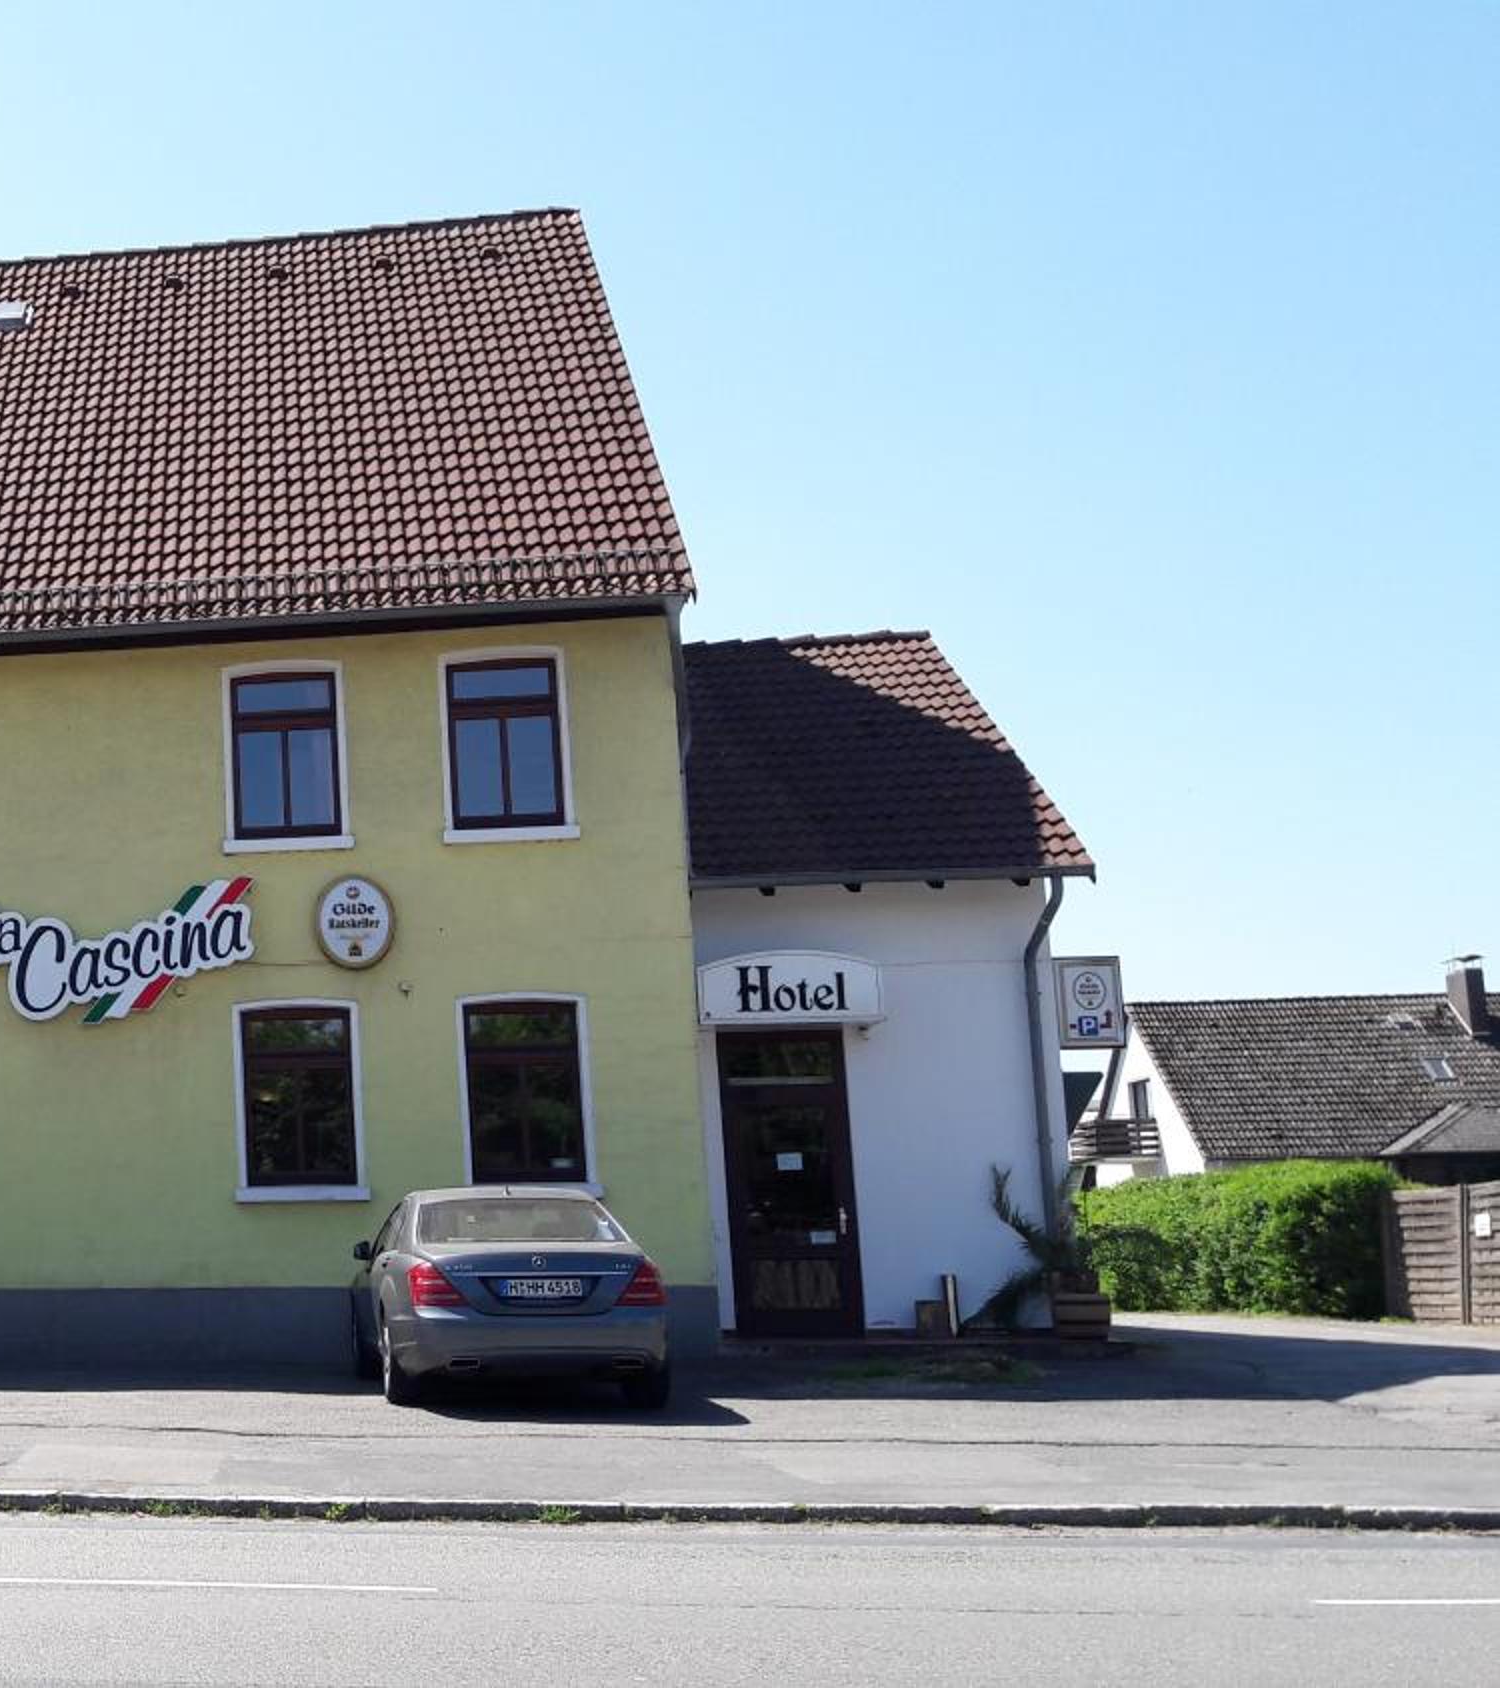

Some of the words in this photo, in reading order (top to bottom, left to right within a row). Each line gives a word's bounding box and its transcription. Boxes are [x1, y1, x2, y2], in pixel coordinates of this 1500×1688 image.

[333, 903, 376, 916] Gilde
[15, 905, 246, 1013] Cascina
[736, 966, 849, 1012] Hotel
